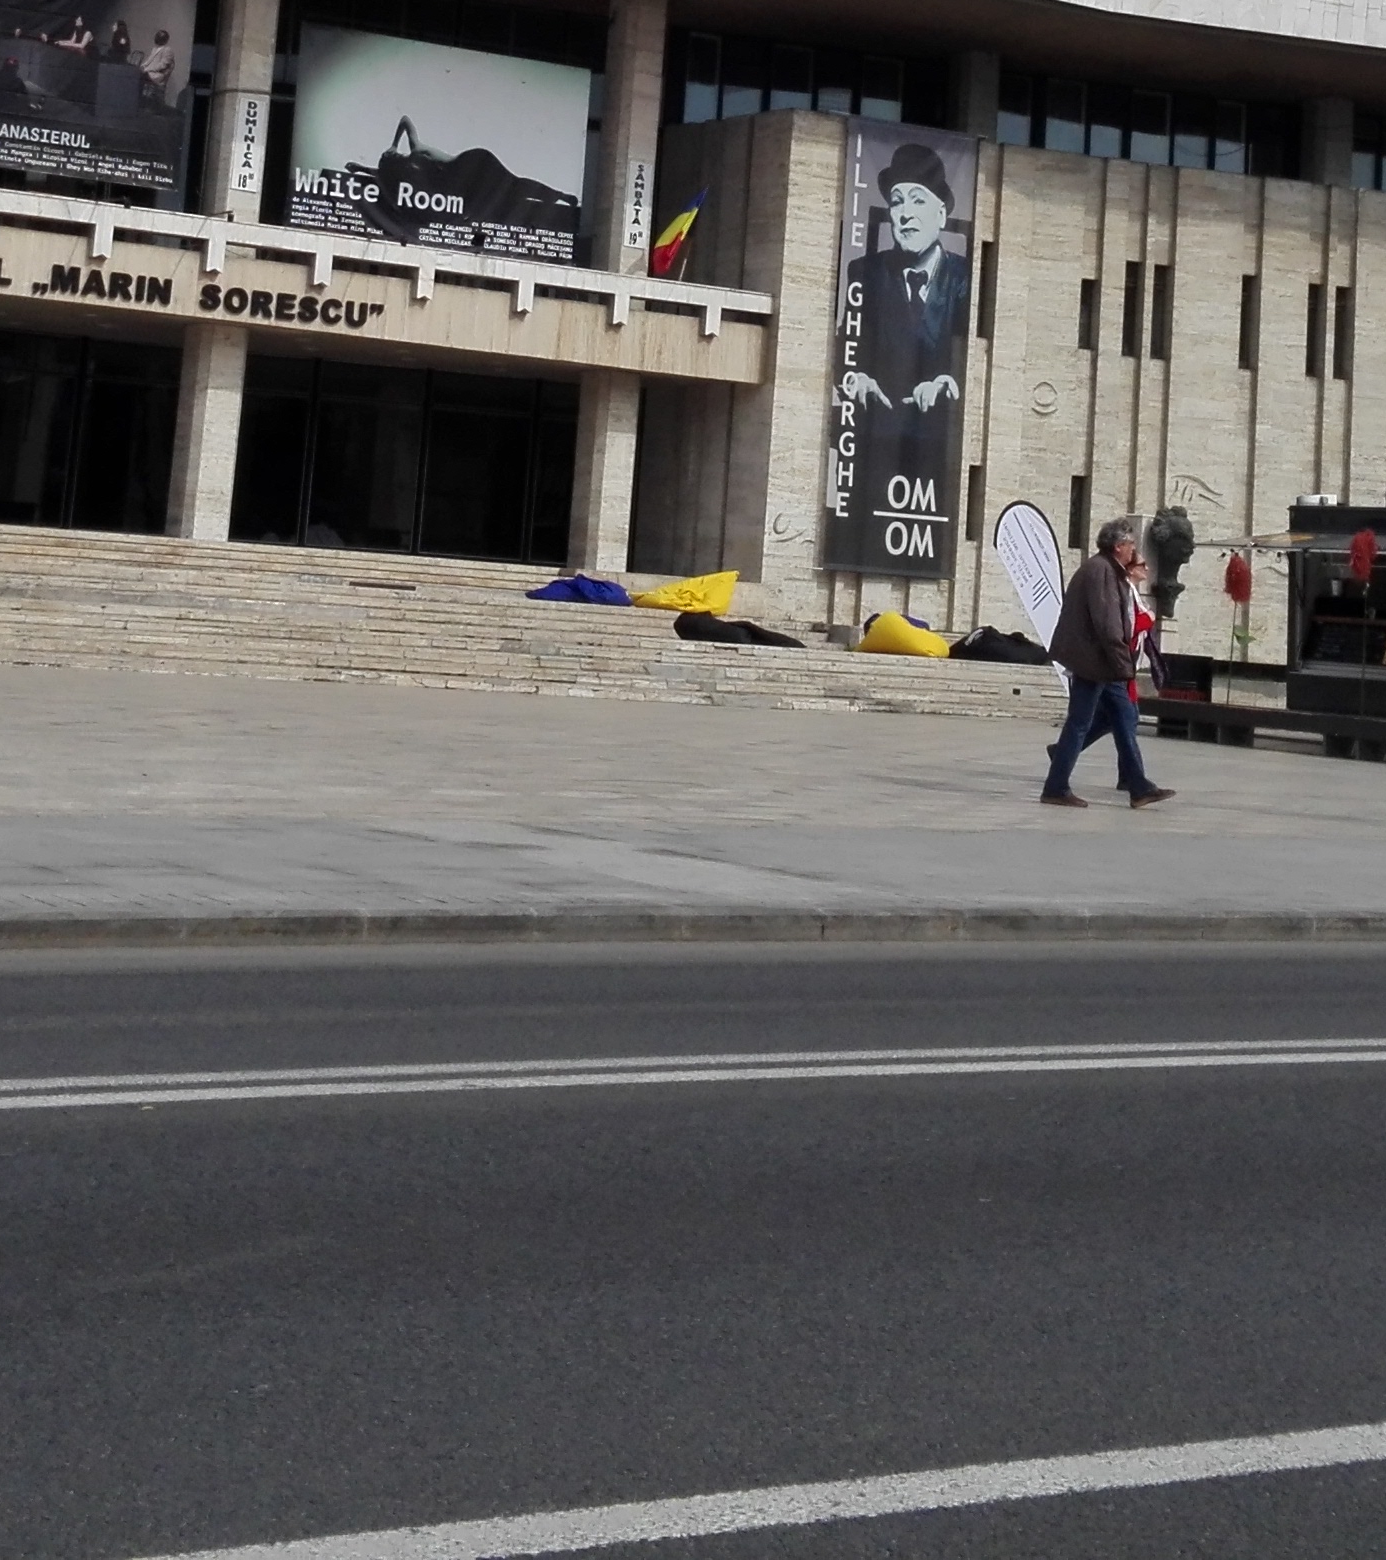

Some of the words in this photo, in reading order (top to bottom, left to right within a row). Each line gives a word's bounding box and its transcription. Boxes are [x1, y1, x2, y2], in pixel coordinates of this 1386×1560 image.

[242, 101, 257, 168] DUMINICA
[294, 167, 380, 203] White
[398, 181, 464, 215] Room
[632, 164, 645, 225] SAMBATA
[851, 133, 868, 249] ILIE
[31, 264, 174, 306] „MARIN
[834, 281, 865, 517] GHEORGHE
[887, 475, 937, 513] OM
[885, 520, 935, 558] OM
